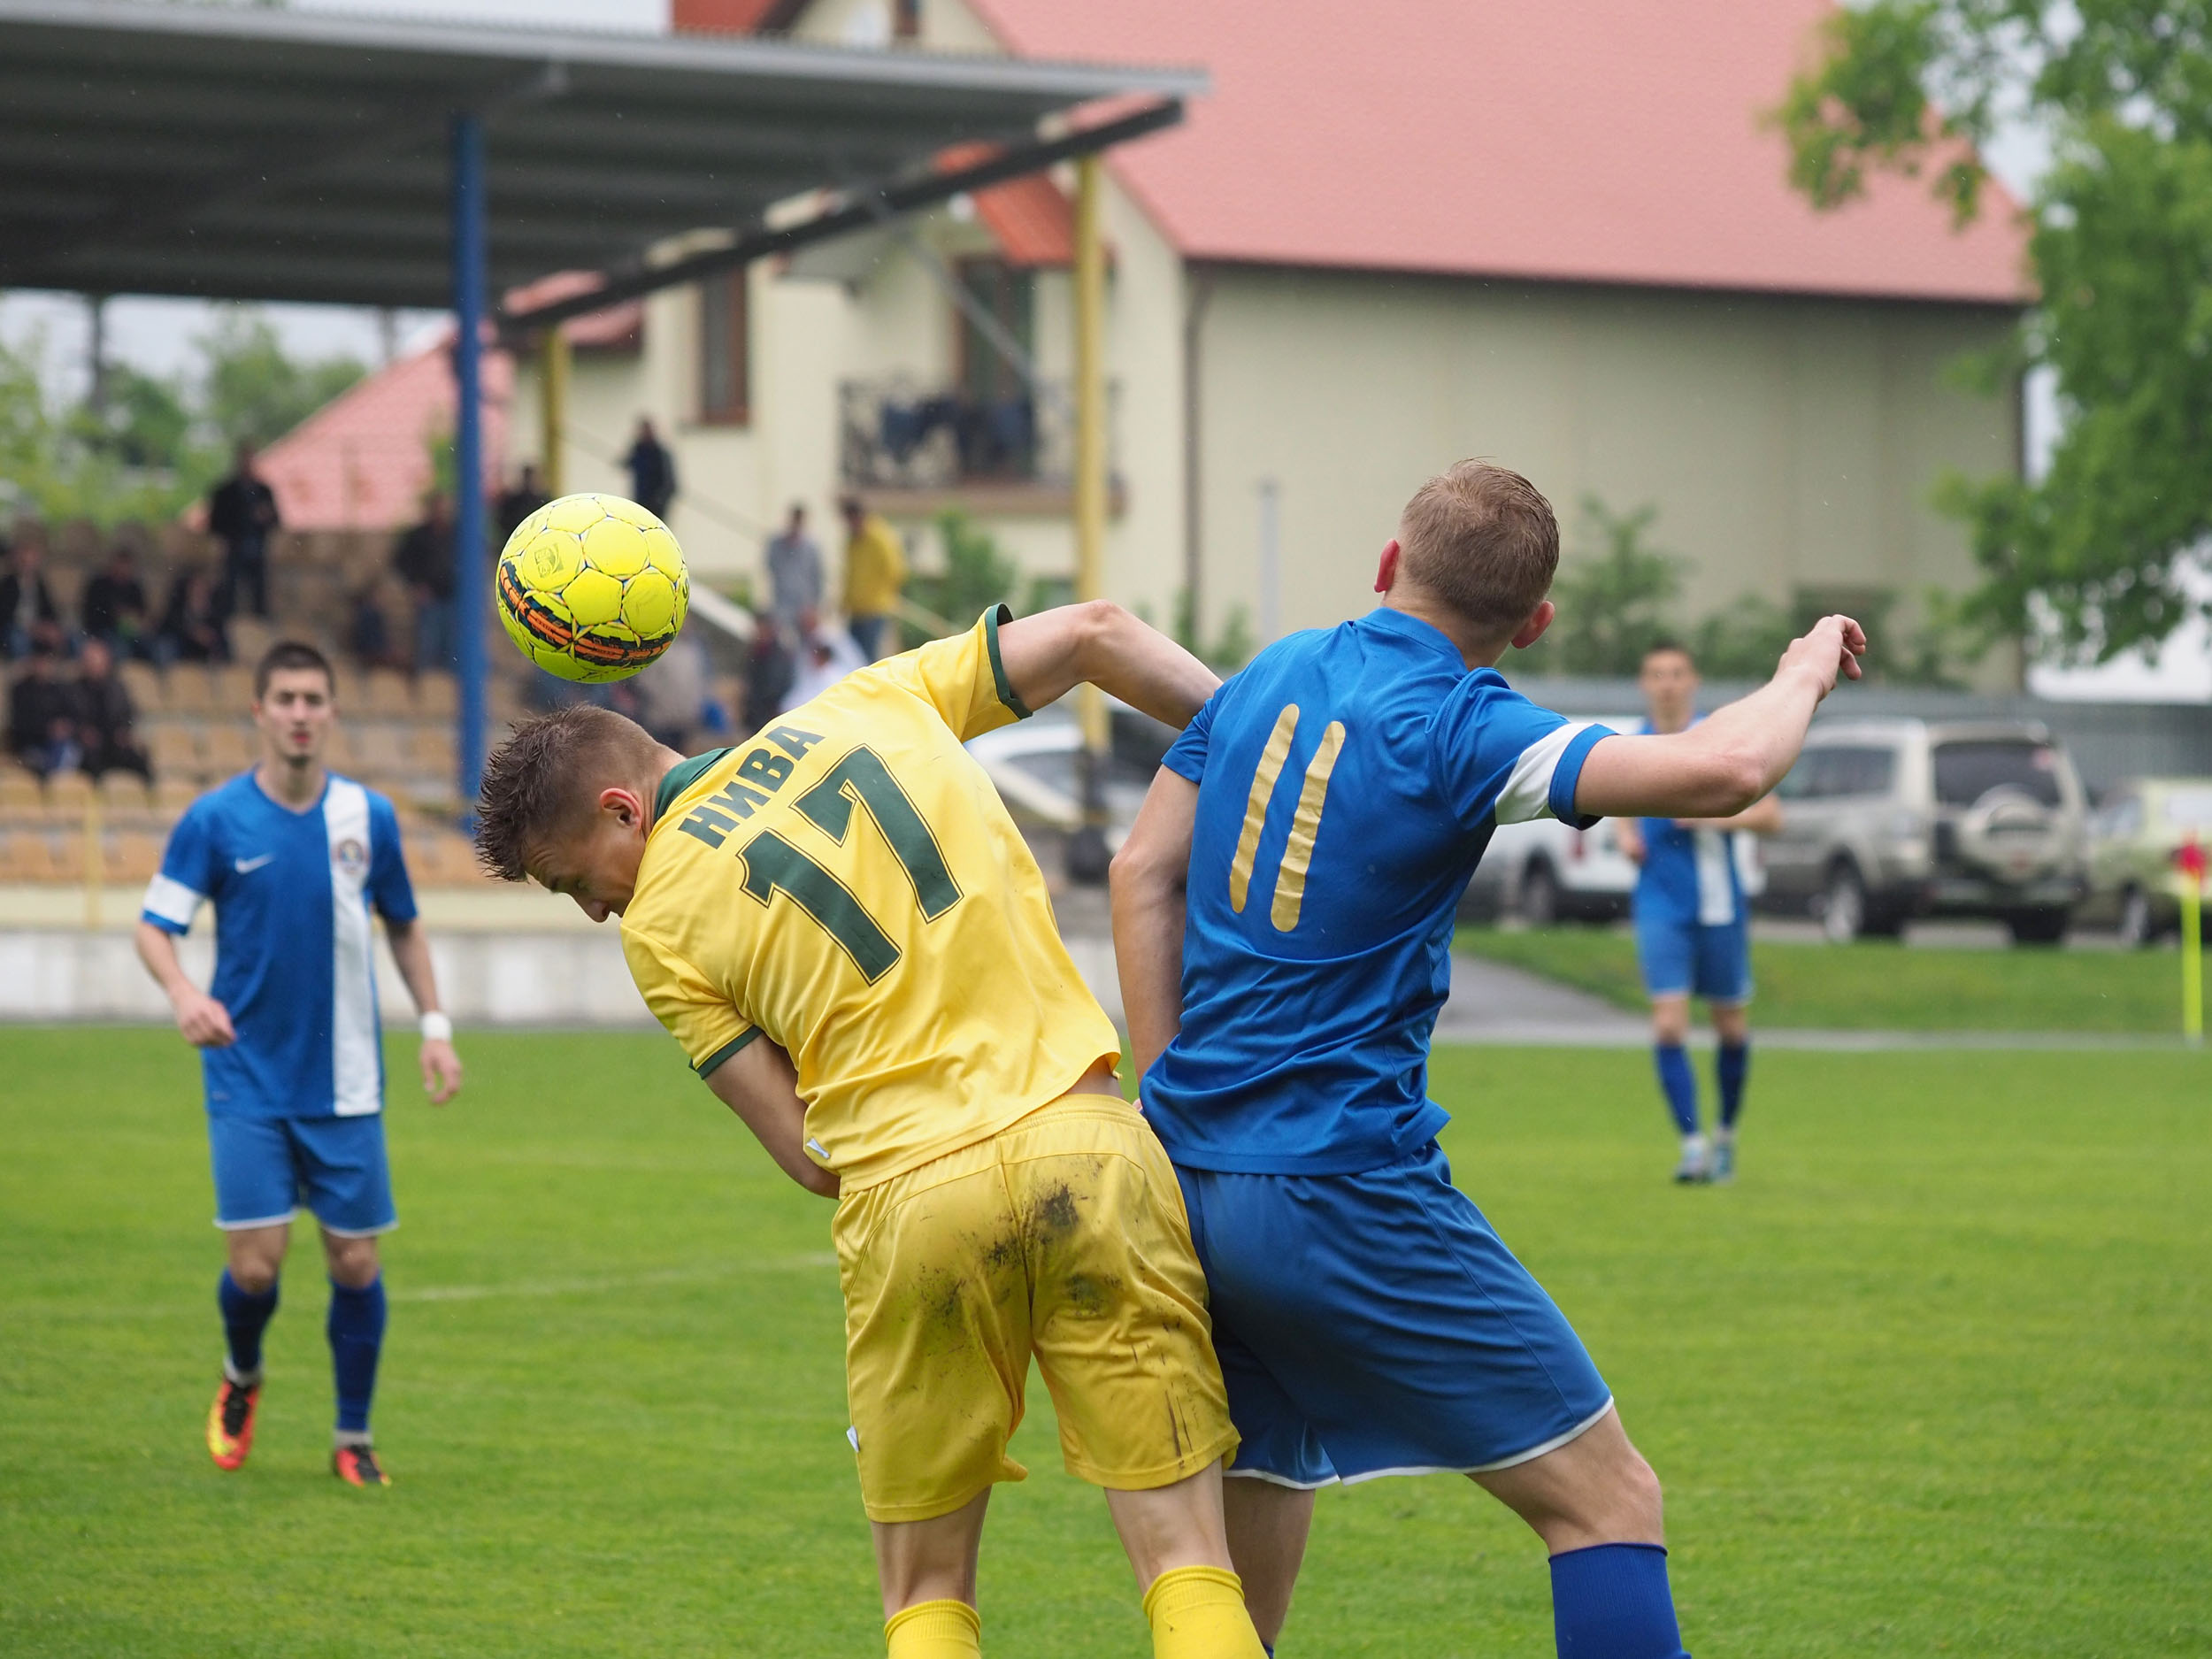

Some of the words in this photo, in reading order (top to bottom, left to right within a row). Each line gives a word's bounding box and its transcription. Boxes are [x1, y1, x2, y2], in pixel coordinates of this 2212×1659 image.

[678, 726, 826, 849] НИВА
[735, 743, 964, 987] 17
[1229, 703, 1346, 932] 11
